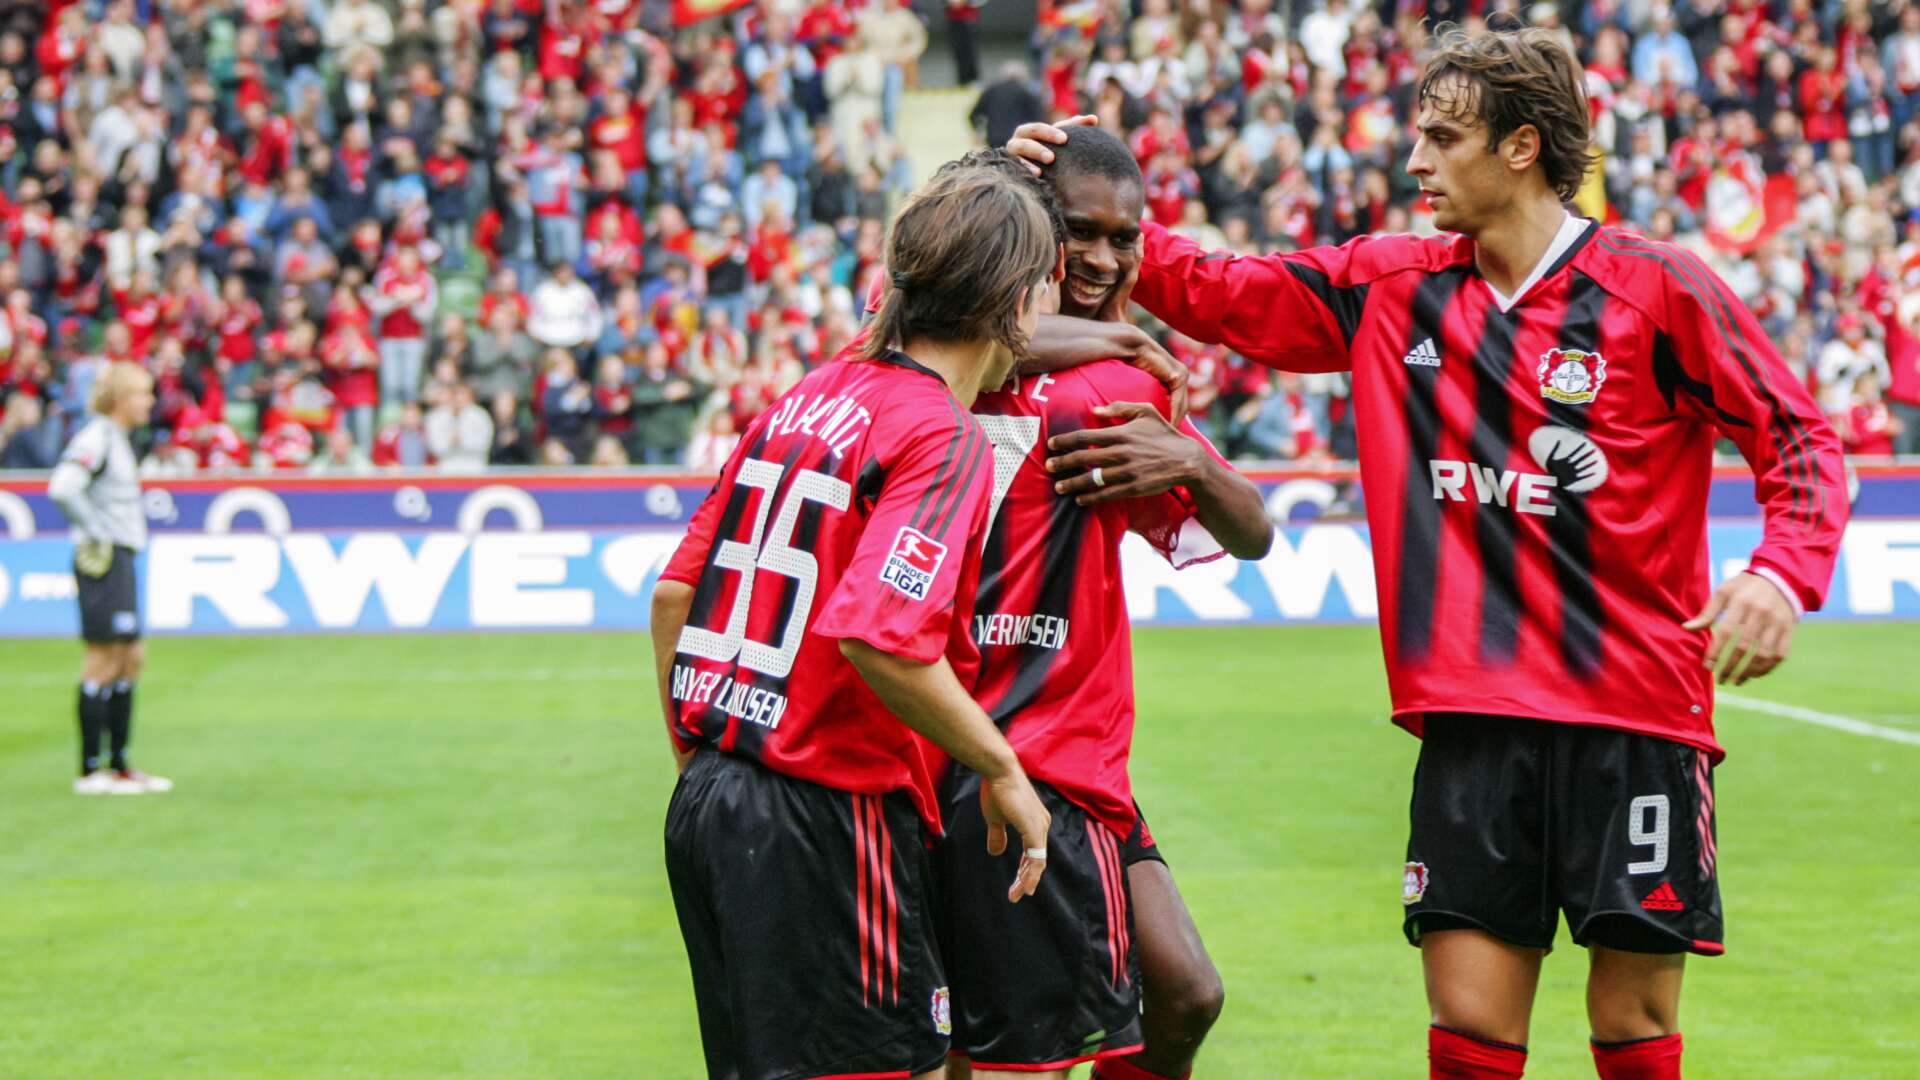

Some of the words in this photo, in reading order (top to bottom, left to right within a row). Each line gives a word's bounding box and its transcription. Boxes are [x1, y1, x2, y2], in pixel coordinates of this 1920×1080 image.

[1430, 459, 1558, 517] RWE
[146, 532, 596, 628] RWE
[676, 456, 852, 679] 35
[883, 565, 924, 599] LIGA
[889, 557, 931, 583] BUNDES
[1119, 525, 1380, 620] RW
[1627, 794, 1670, 875] 9
